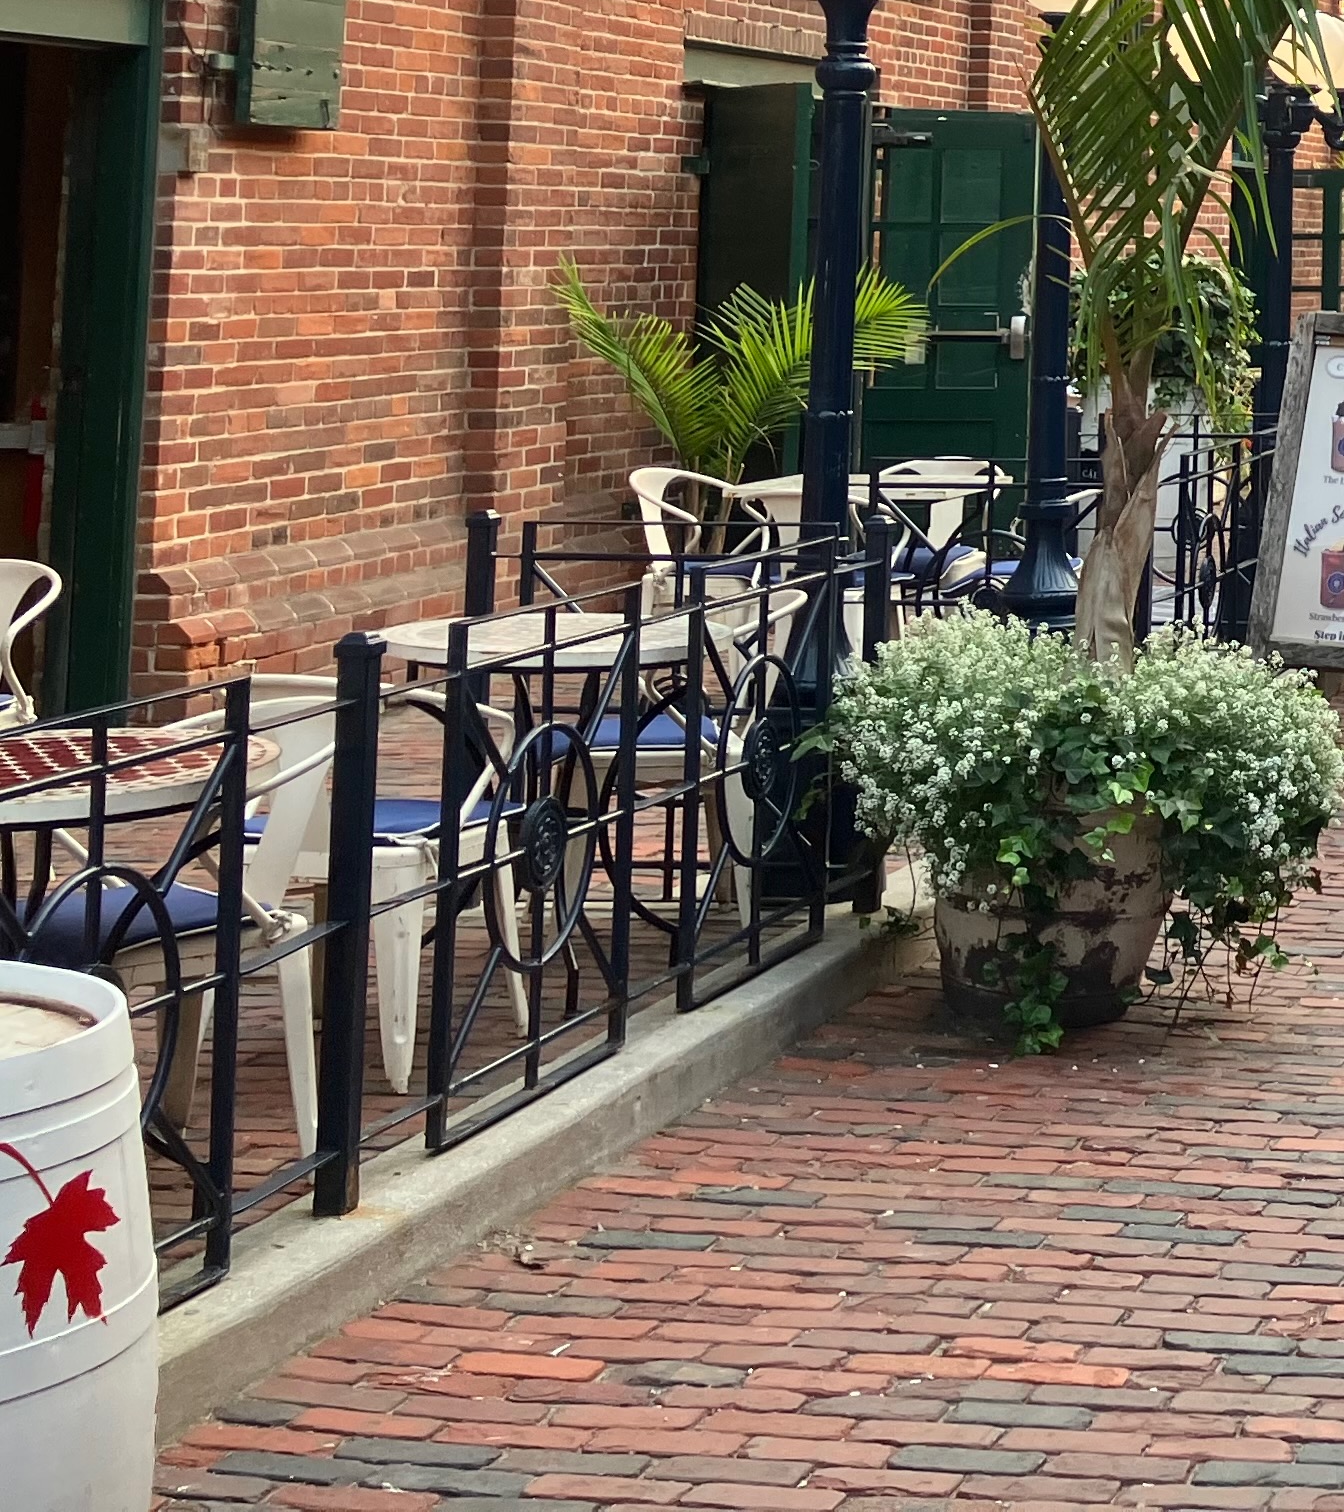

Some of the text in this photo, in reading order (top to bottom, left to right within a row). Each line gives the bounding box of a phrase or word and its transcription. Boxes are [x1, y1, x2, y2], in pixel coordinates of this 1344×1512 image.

[1323, 475, 1339, 484] The
[1293, 517, 1328, 558] Italian
[1314, 629, 1336, 641] Step
